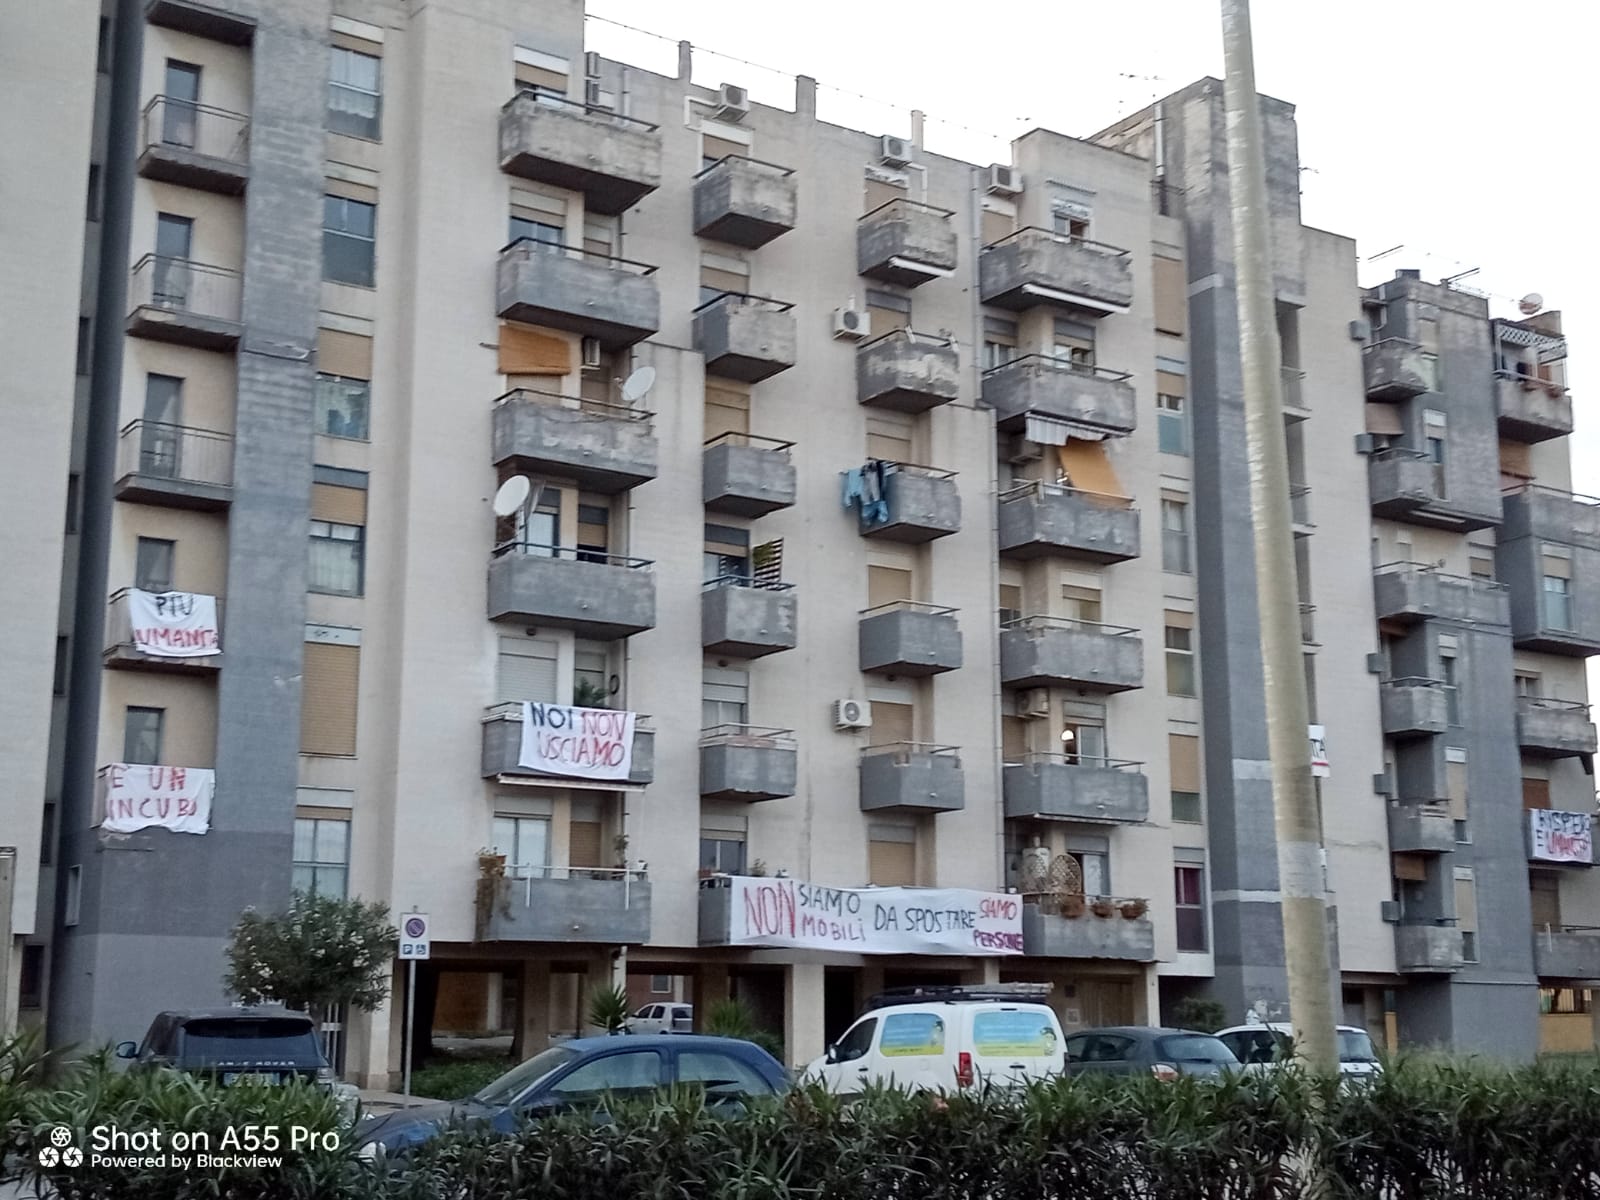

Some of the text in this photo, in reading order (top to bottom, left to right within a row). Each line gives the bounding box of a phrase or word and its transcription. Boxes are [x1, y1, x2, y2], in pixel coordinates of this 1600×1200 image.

[530, 702, 627, 741] NOI NON
[537, 731, 625, 768] USCIAMO
[743, 880, 861, 938] NON SIAMO
[874, 904, 977, 933] DA SPOSTARE
